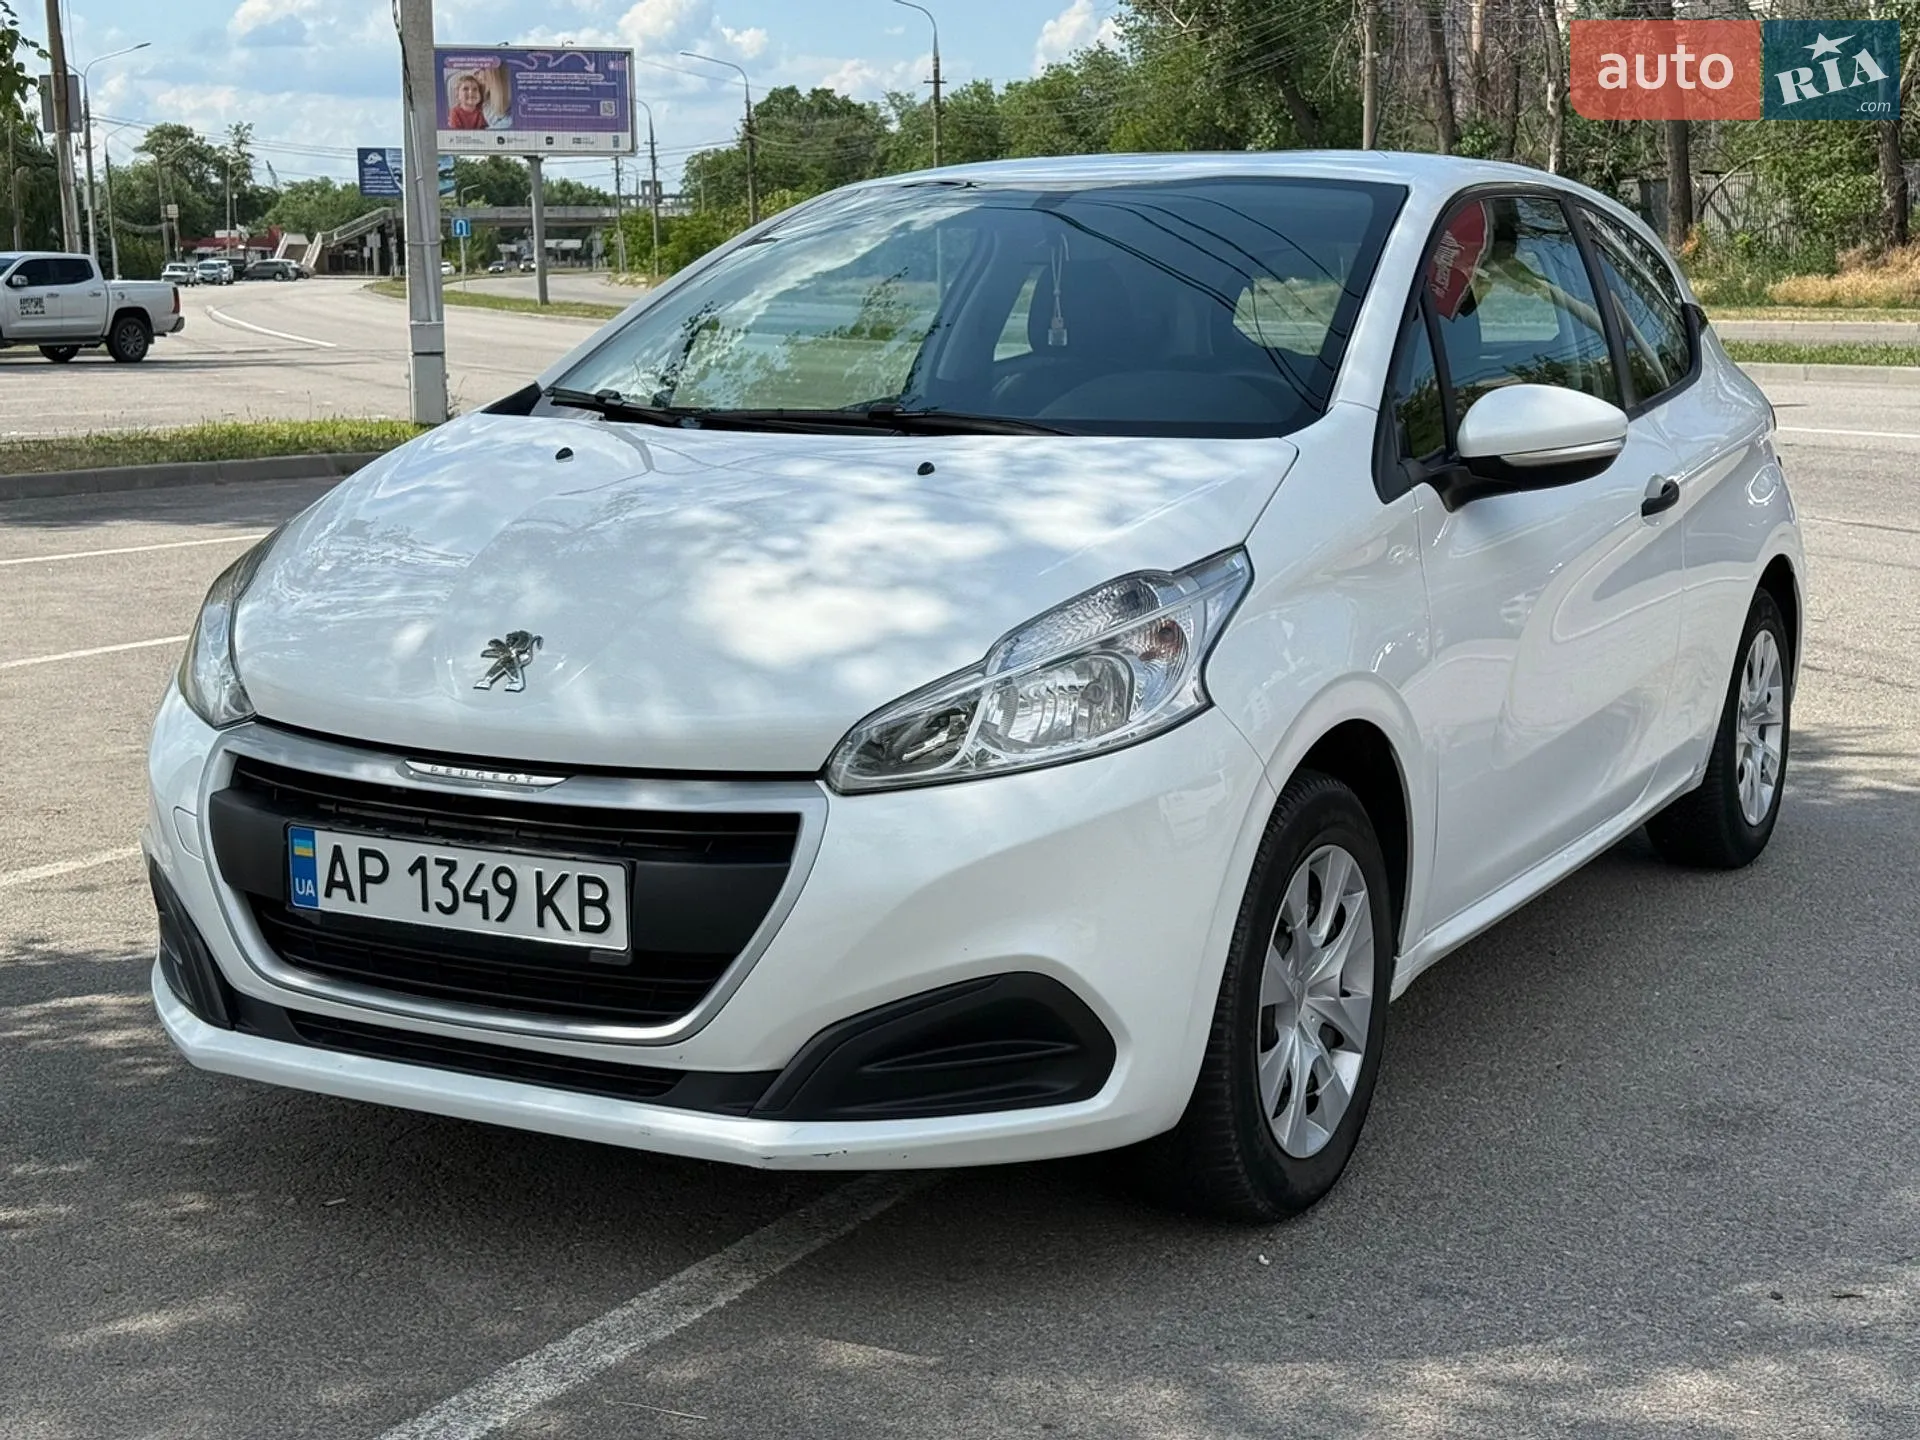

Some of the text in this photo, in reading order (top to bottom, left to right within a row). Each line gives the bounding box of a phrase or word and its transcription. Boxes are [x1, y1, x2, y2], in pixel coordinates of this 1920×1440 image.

[430, 764, 533, 784] PEUGEOT
[295, 878, 315, 897] UA
[324, 844, 612, 934] AP 1349 KB
